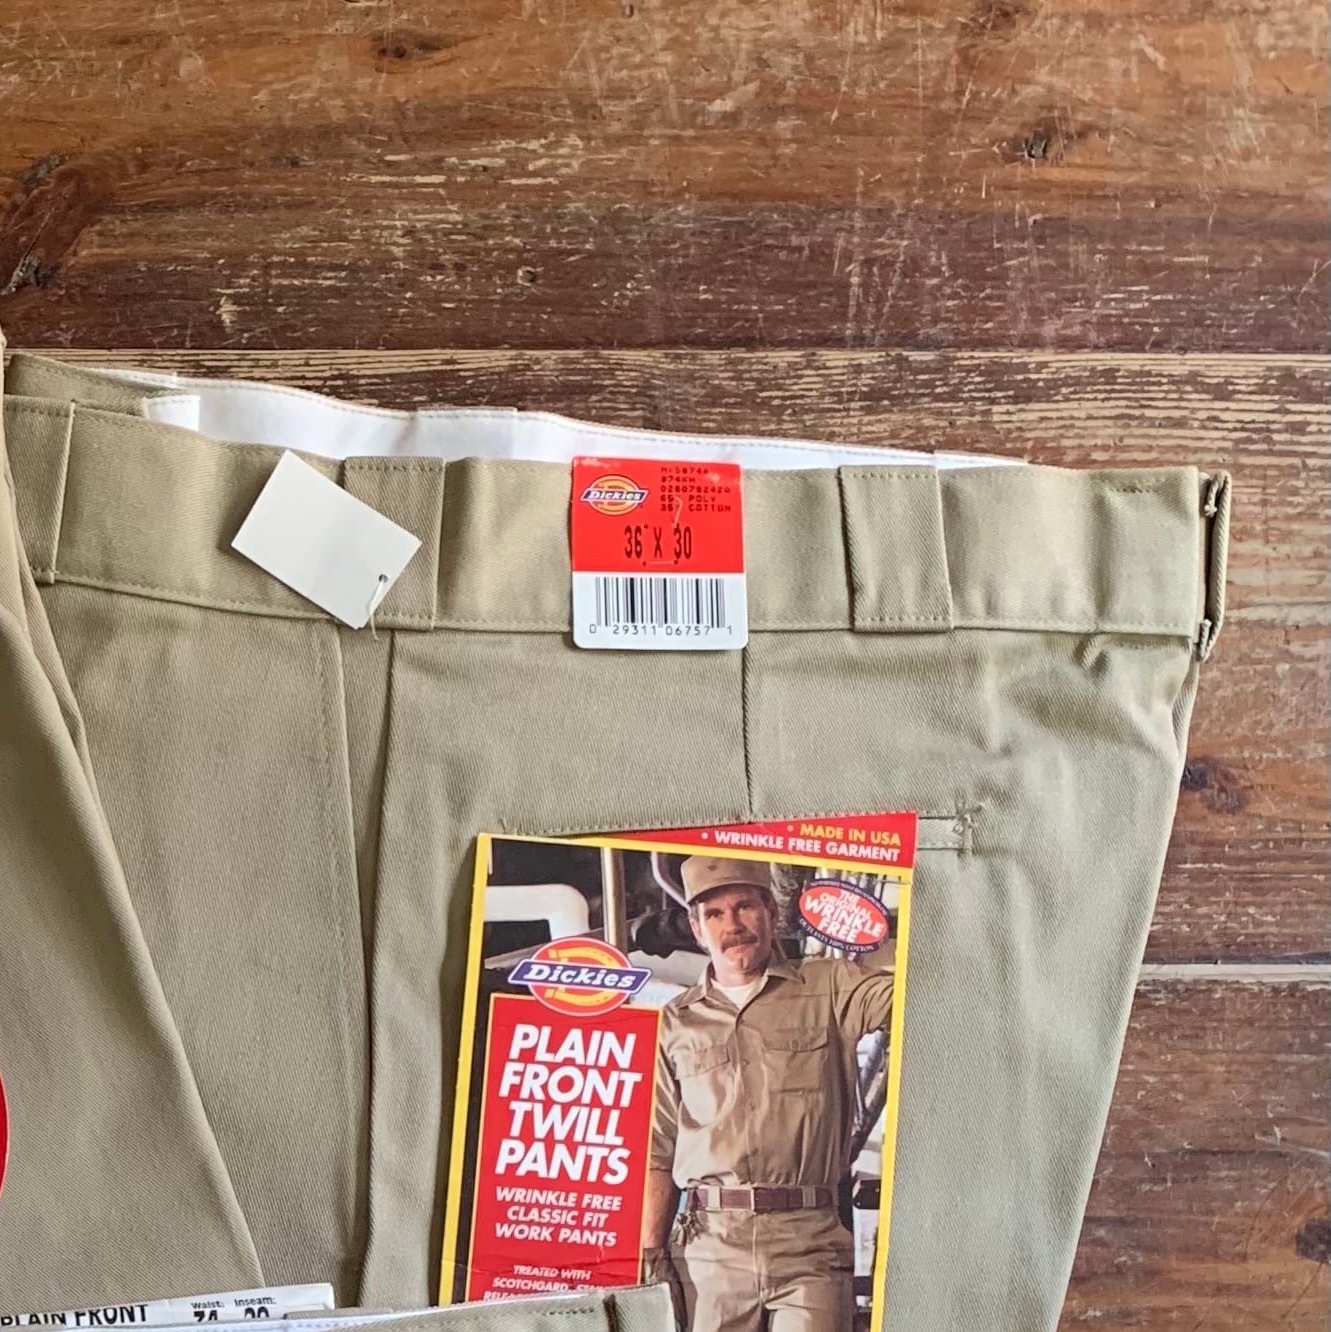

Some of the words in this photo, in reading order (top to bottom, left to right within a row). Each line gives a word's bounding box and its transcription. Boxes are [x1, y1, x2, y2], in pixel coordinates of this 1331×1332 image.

[587, 490, 642, 502] Dickies
[688, 494, 716, 503] POLY
[688, 503, 732, 512] COTTON
[624, 525, 643, 559] 36
[653, 526, 663, 559] X
[674, 525, 692, 559] 30
[589, 624, 596, 634] 0
[613, 624, 657, 636] 29311
[666, 626, 711, 636] 06757
[714, 830, 784, 850] WRINKLE
[788, 838, 822, 854] FREE
[824, 842, 900, 862] GARMENT
[800, 823, 844, 840] MADE
[848, 828, 866, 842] IN
[870, 830, 902, 846] USA
[804, 894, 885, 938] WRINKLE
[820, 892, 873, 920] ORIGINAL
[818, 918, 858, 944] FREE
[523, 964, 636, 988] Dickies
[508, 1024, 636, 1069] PLAIN
[498, 1062, 642, 1108] FRONT
[508, 1101, 624, 1146] TWILL
[494, 1138, 631, 1184] PANTS
[495, 1186, 578, 1208] WRINKLE
[581, 1193, 623, 1212] FREE
[507, 1205, 578, 1226] CLASSIC
[582, 1212, 609, 1228] FIT
[494, 1222, 554, 1242] WORK
[558, 1228, 618, 1246] PANTS
[512, 1264, 559, 1278] TREATED
[560, 1268, 592, 1281] WITH
[492, 1277, 568, 1293] SCOTCHGARD
[74, 1304, 148, 1326] FRONT
[190, 1300, 225, 1310] Waist:
[234, 1296, 277, 1307] Inseam:
